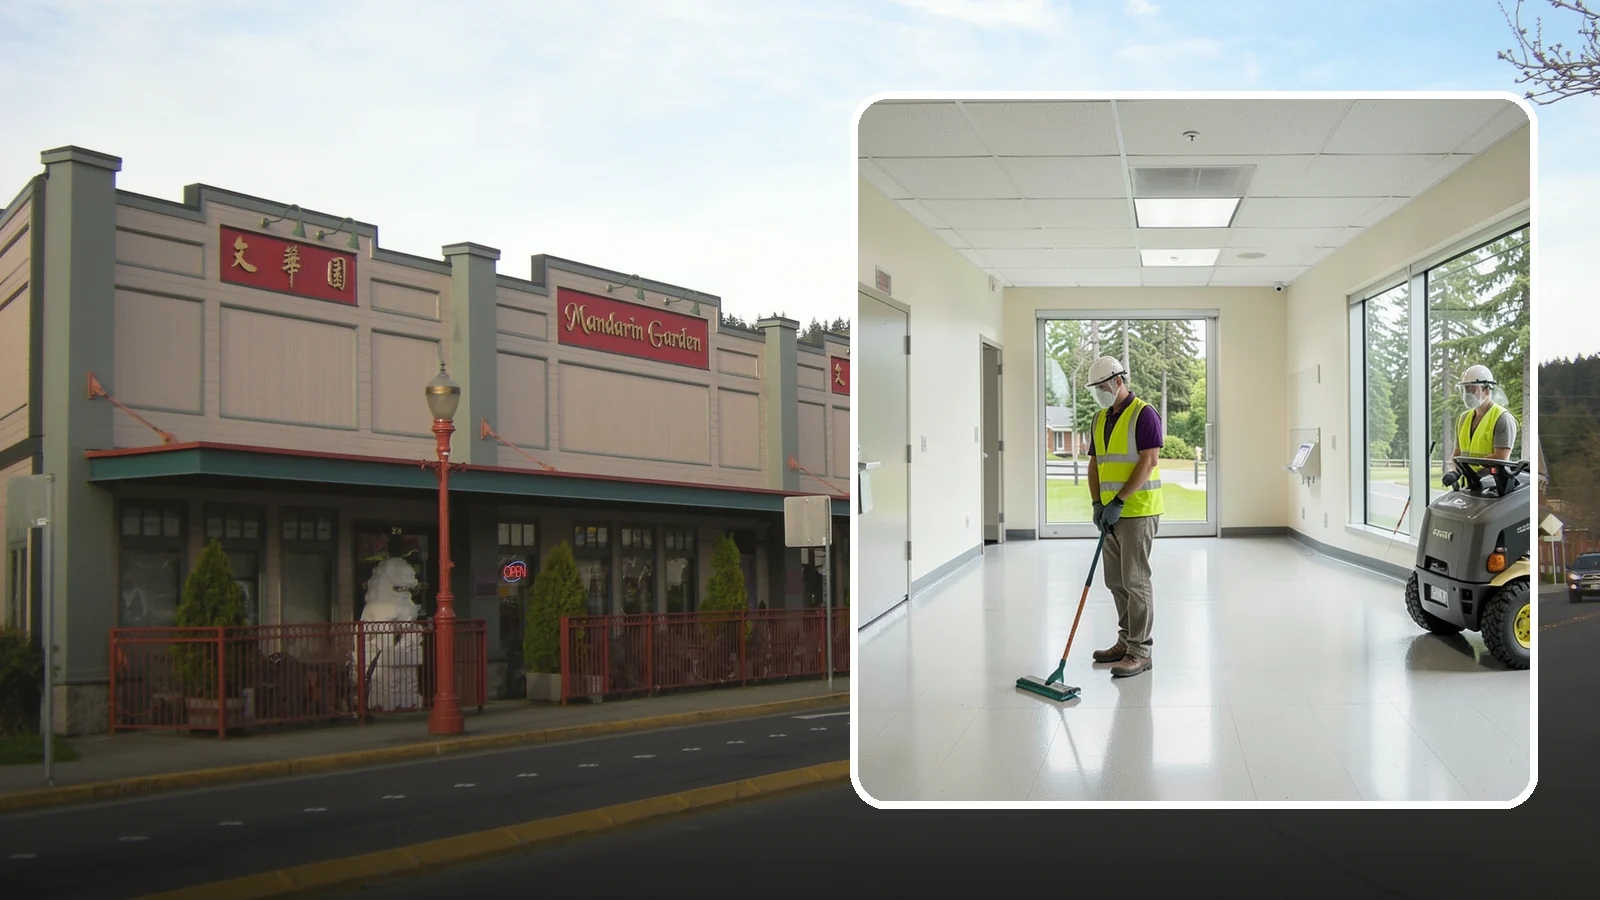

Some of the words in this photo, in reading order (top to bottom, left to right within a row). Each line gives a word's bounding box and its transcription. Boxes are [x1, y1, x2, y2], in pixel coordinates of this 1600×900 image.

[230, 235, 346, 291] 文華園
[564, 302, 644, 341] Mandarin
[648, 320, 702, 352] Garden
[503, 565, 527, 578] OPEN
